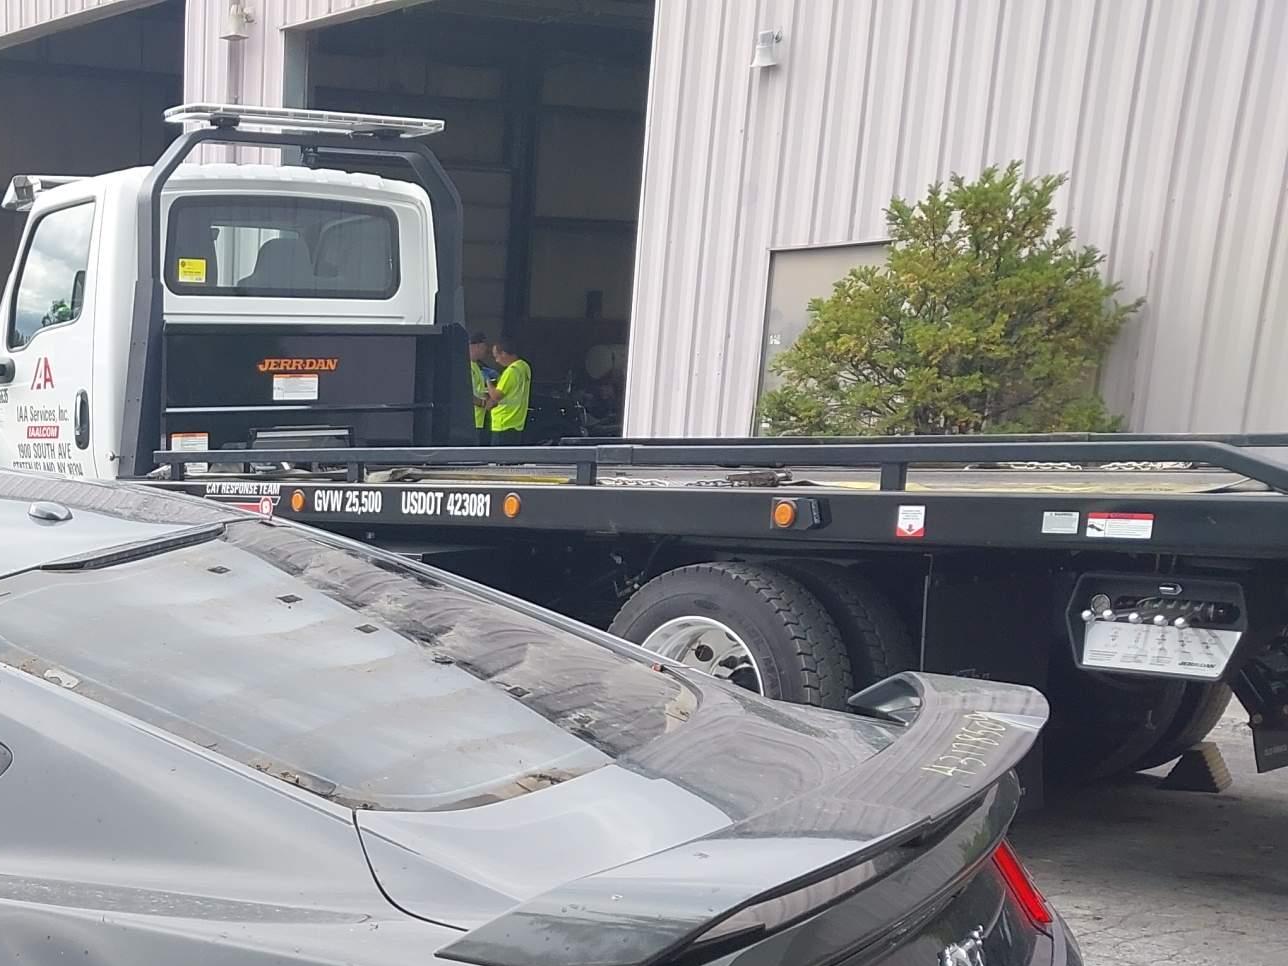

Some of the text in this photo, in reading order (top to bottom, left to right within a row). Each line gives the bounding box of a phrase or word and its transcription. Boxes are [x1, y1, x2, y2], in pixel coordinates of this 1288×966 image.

[16, 405, 28, 422] IAA
[29, 404, 57, 423] Services,
[58, 404, 70, 422] Inc.
[32, 442, 56, 460] SOUTH
[58, 442, 72, 460] AVE
[206, 483, 281, 495] CAT RESPONSE TEAM
[314, 490, 382, 515] GVW 25,500
[401, 491, 491, 517] USDOT 423081
